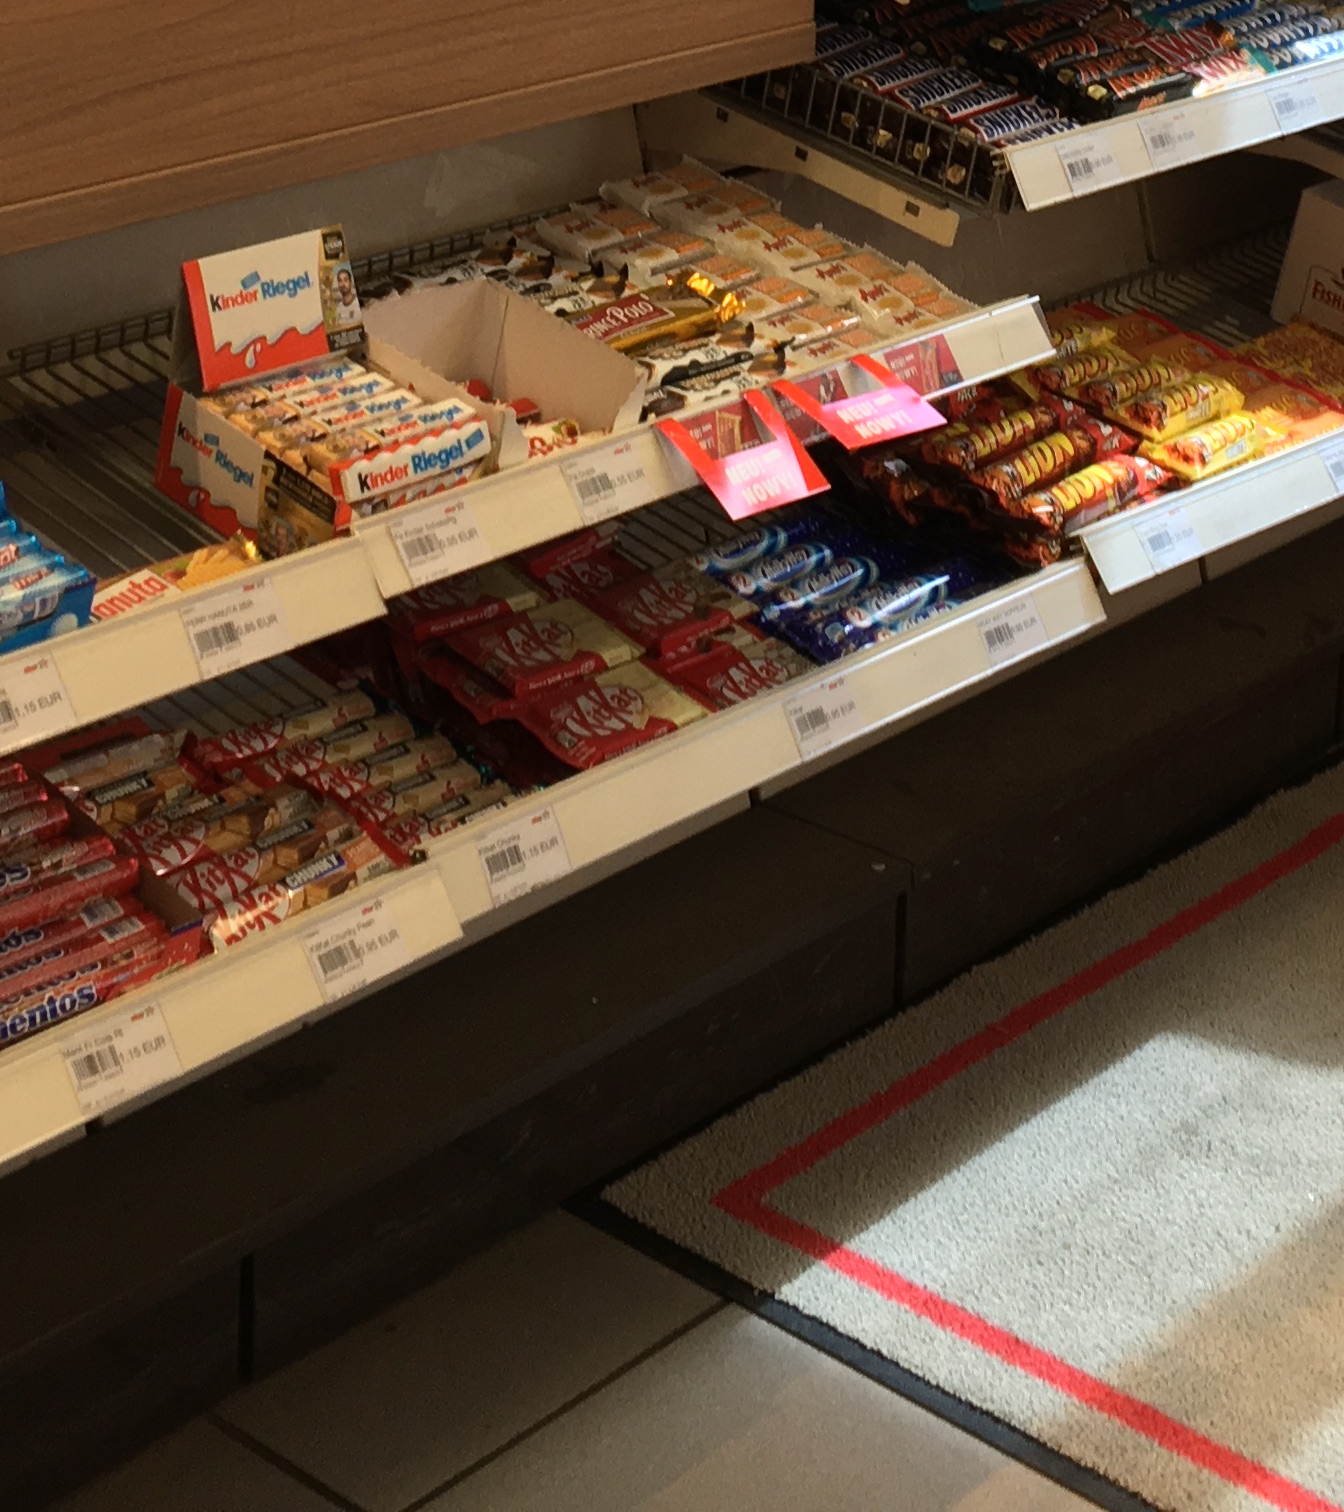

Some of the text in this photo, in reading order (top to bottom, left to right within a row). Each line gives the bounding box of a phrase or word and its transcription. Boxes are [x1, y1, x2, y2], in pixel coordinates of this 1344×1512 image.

[1146, 25, 1226, 66] TWIX
[981, 99, 1058, 140] SNICKERS
[260, 274, 312, 300] Riegel
[835, 399, 876, 426] NEU!
[855, 410, 914, 440] NOWY!
[971, 411, 1034, 456] LION
[213, 450, 256, 488] Riegel
[411, 438, 466, 474] Riegel
[725, 456, 764, 486] NEU!
[1016, 430, 1076, 482] LION
[742, 472, 798, 508] NOWY!
[1052, 463, 1116, 510] LION
[256, 613, 278, 632] EUR
[492, 612, 576, 670] KitKat
[38, 691, 64, 710] EUR
[548, 690, 646, 748] KitKat
[285, 853, 342, 890] CHUNKY
[142, 1035, 168, 1056] EUR
